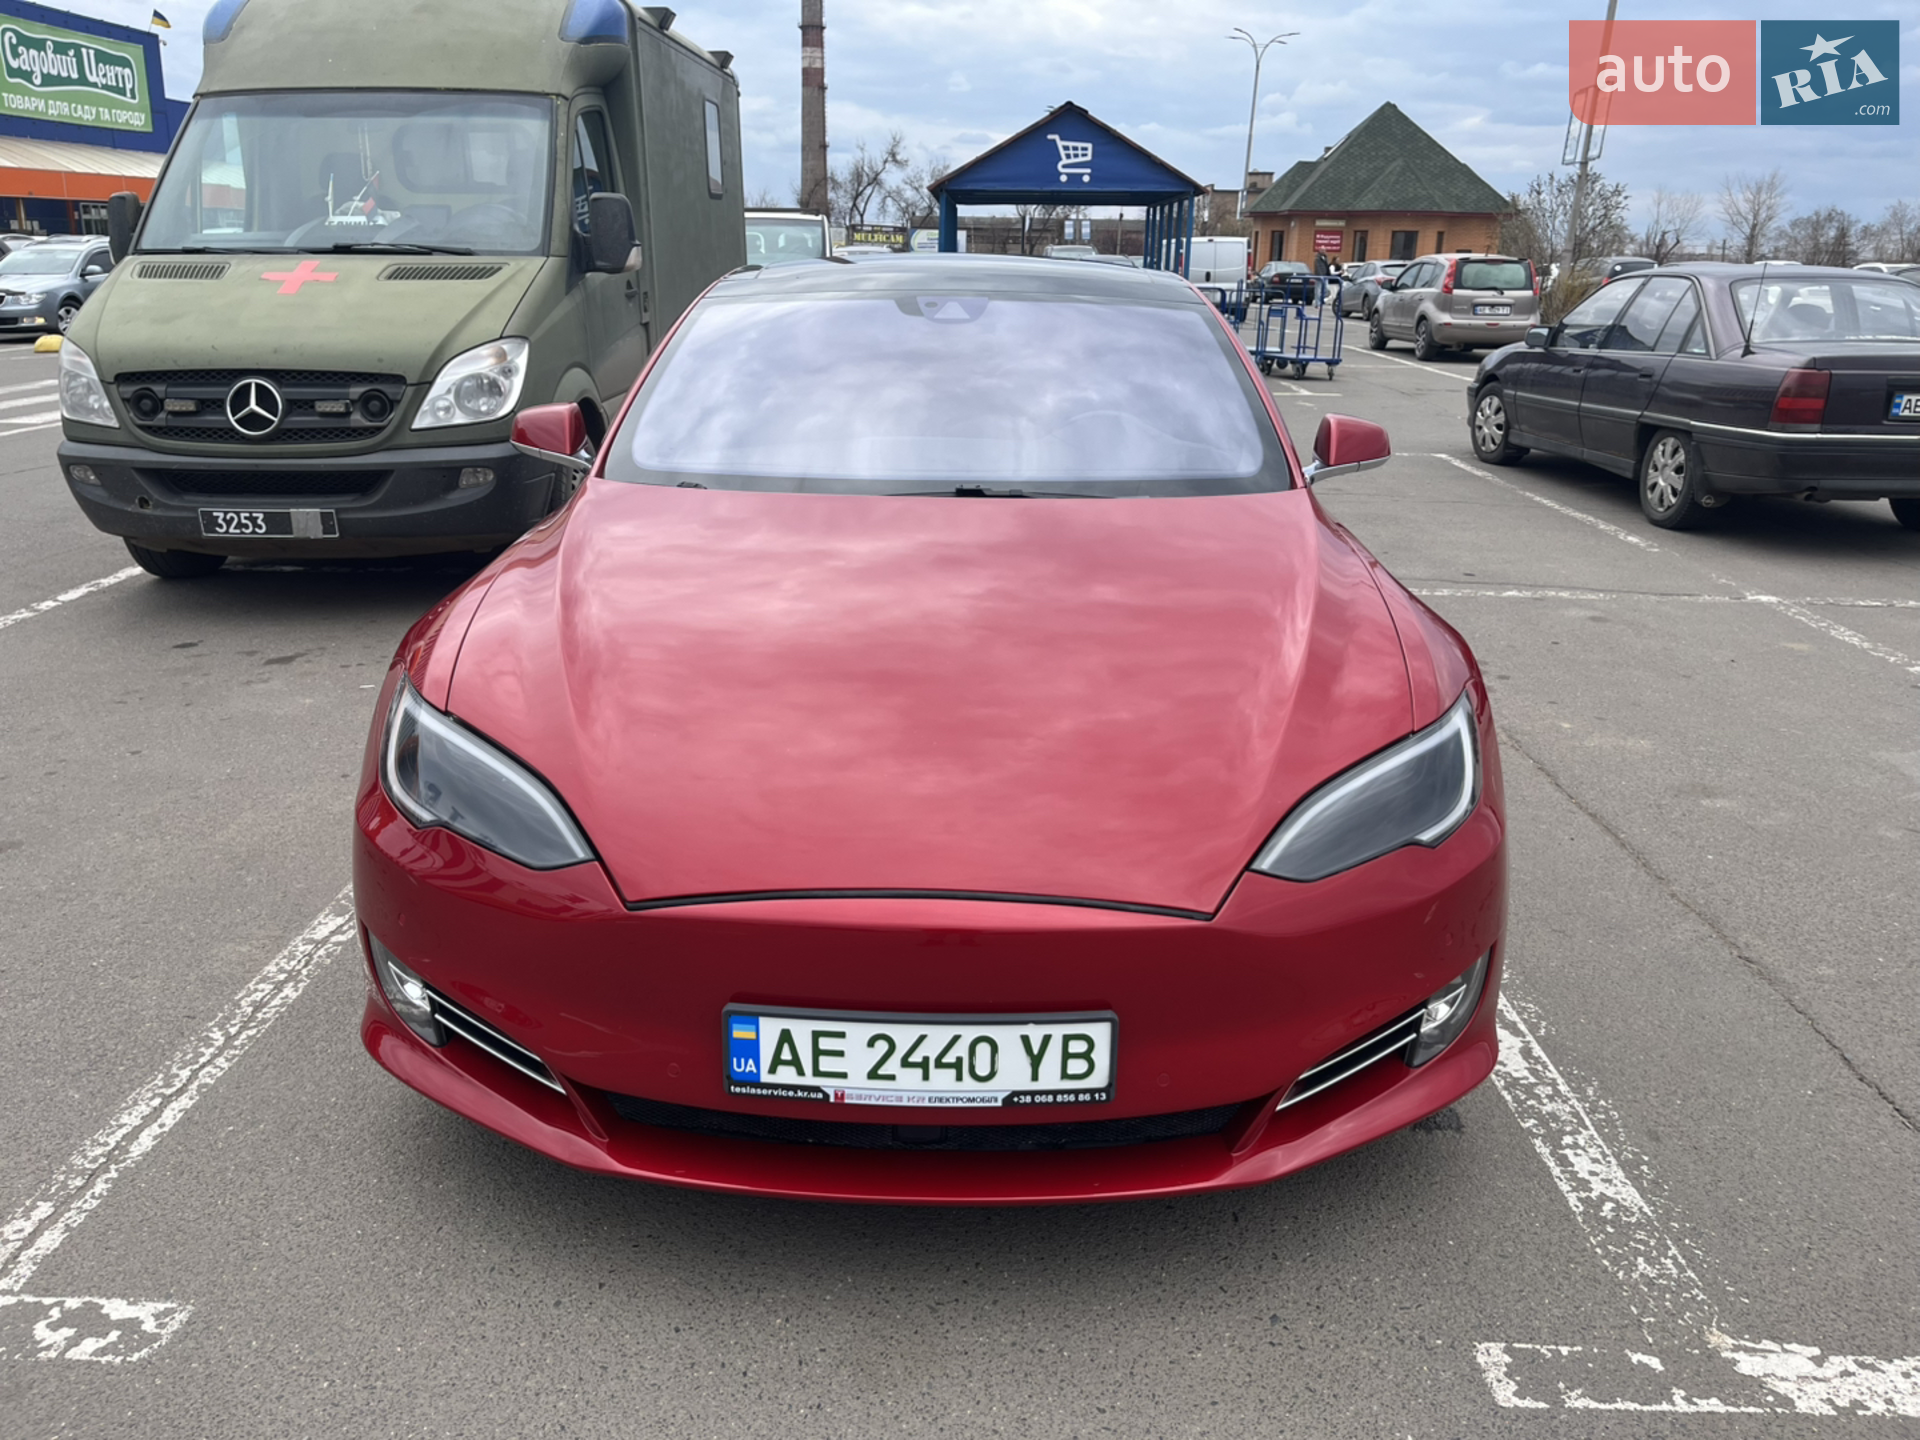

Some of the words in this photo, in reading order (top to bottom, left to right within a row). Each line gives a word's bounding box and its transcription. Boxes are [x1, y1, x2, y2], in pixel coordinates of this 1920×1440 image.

[3, 31, 79, 86] Садовий
[81, 48, 133, 98] Центр
[2, 92, 46, 113] ТОВАРИ
[48, 100, 70, 116] ДЛЯ
[71, 103, 96, 121] САДУ
[98, 107, 111, 122] ТА
[112, 110, 146, 127] ГОРОДУ
[212, 511, 267, 534] 3253
[732, 1057, 758, 1074] UA
[767, 1028, 849, 1079] AE
[866, 1033, 999, 1083] 2440
[1020, 1033, 1096, 1082] YB
[730, 1084, 824, 1099] teslaservice.kr.ua
[1013, 1095, 1031, 1104] +38
[1034, 1094, 1054, 1103] 068
[1078, 1092, 1091, 1102] 86
[1094, 1091, 1107, 1101] 13
